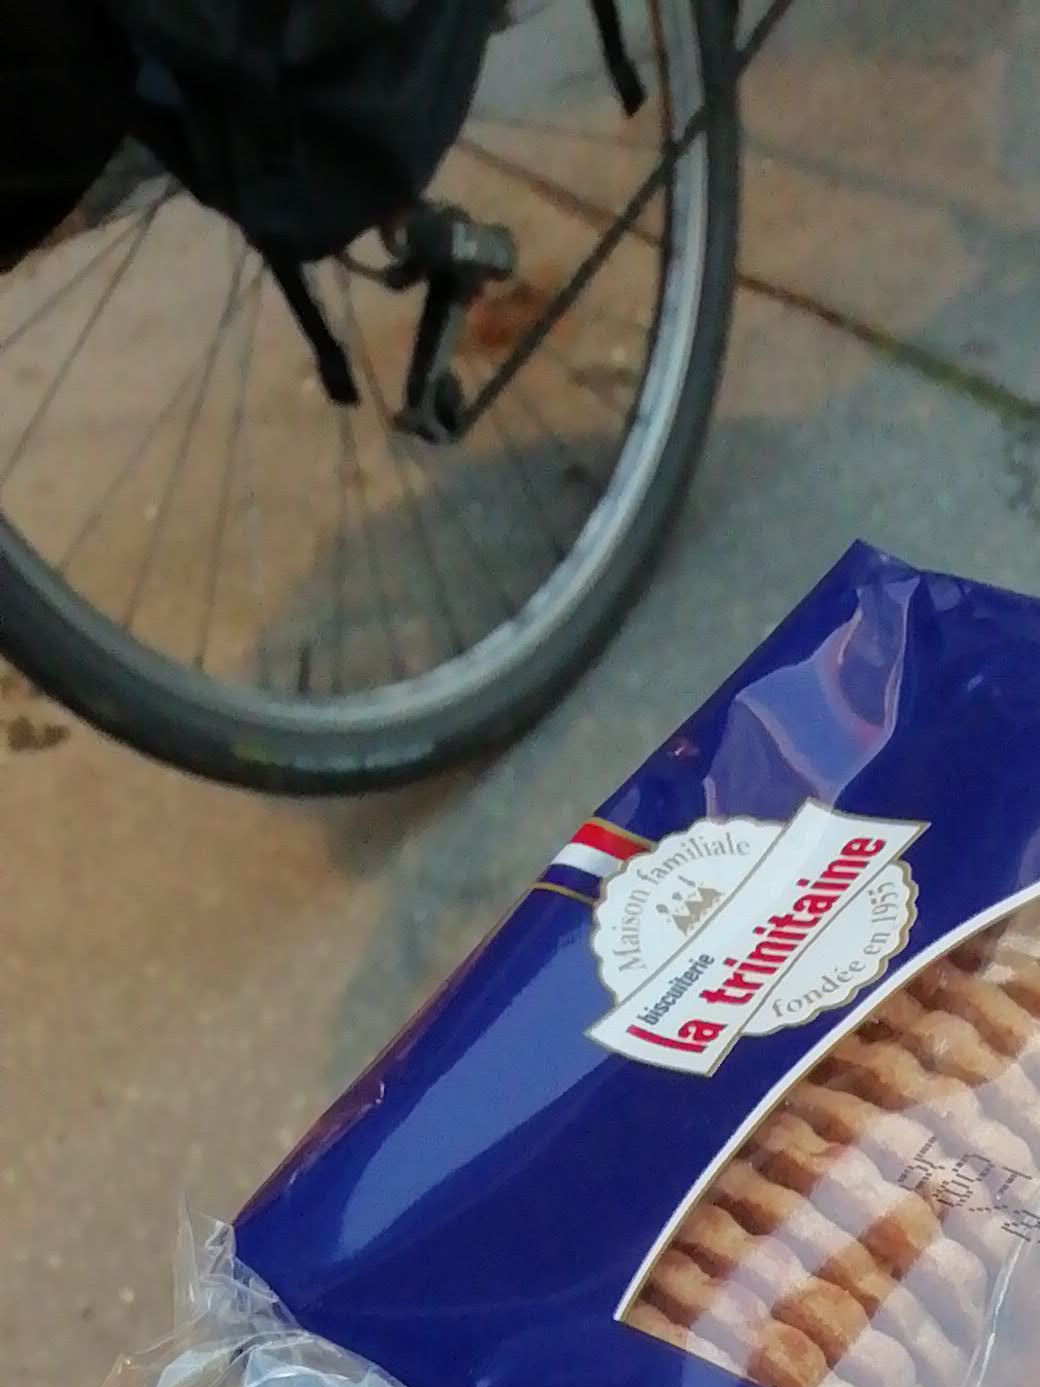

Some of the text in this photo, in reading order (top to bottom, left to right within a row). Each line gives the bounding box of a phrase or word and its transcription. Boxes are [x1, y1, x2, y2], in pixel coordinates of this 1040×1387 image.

[613, 837, 751, 970] Maison familiale
[625, 833, 886, 1053] la trinitaine
[768, 877, 897, 1017] fondée 1955
[637, 948, 716, 1028] biscuiterie
